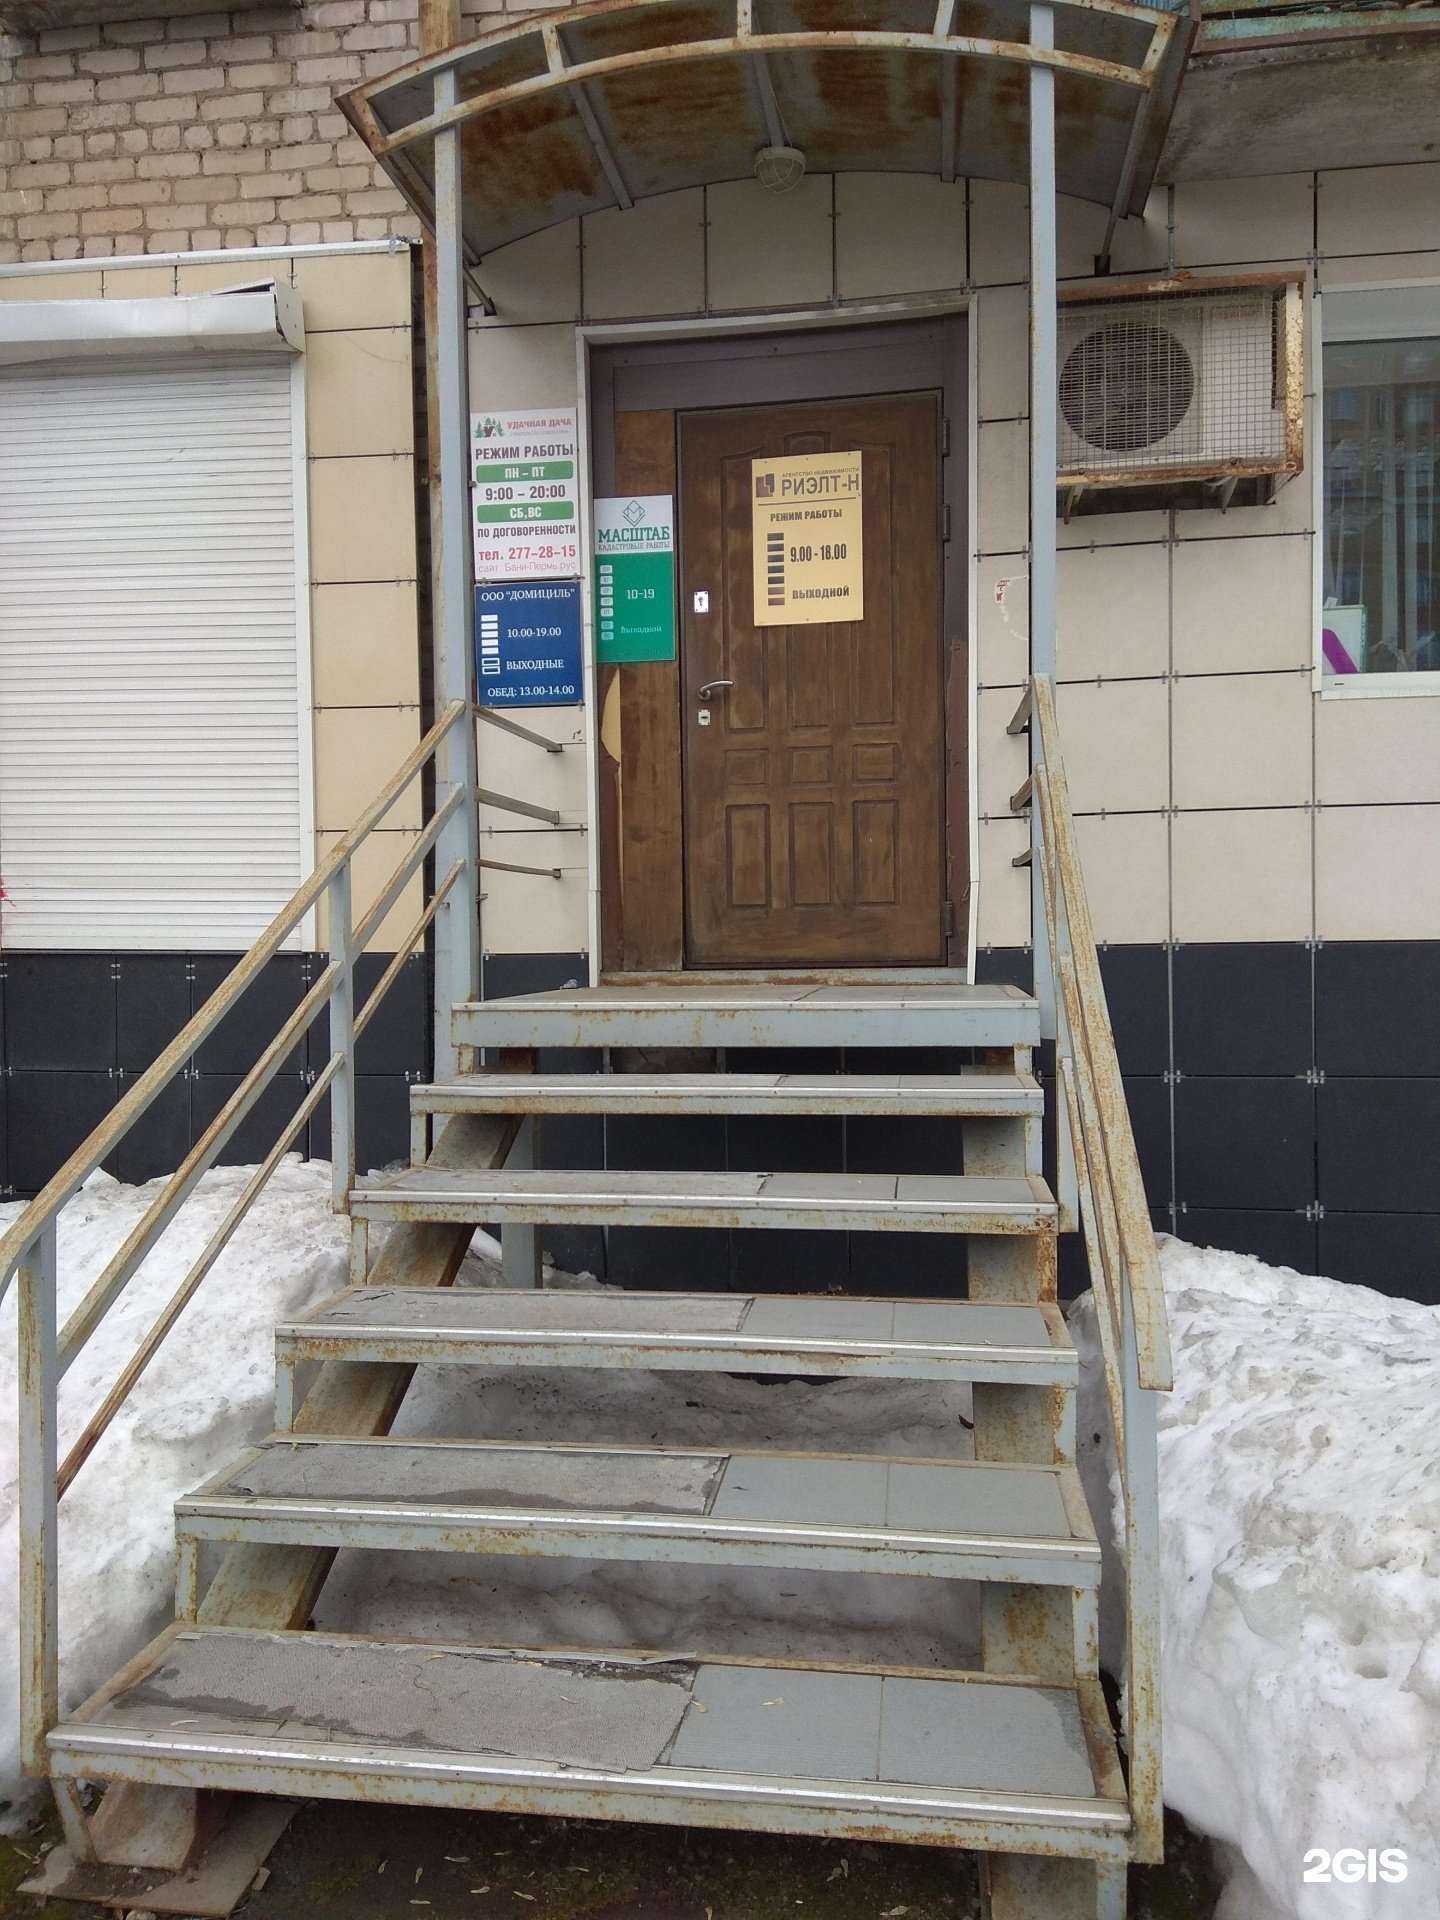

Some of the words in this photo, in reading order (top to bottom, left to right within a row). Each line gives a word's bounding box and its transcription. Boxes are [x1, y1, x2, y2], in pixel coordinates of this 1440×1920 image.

[507, 418, 547, 430] УДАЧНАЯ
[549, 417, 572, 428] ДАЧА
[475, 446, 520, 460] РЕЖИМ
[524, 444, 574, 458] РАБОТЫ
[505, 467, 520, 478] ПН
[532, 466, 545, 477] ПТ
[781, 473, 859, 496] РИЭЛТ-Н
[485, 488, 514, 501] 9:00
[529, 485, 566, 499] 20:00
[770, 511, 802, 522] РЕЖИМ
[805, 508, 842, 520] РАБОТЫ
[477, 528, 491, 539] ПО
[493, 525, 576, 539] ДОГОВОРЕННОСТИ
[598, 526, 670, 543] МАСШТАБ
[479, 550, 504, 561] тел.
[508, 544, 576, 560] 277-28-15
[790, 545, 812, 562] 9.00
[820, 543, 847, 561] 18.00
[481, 591, 505, 601] ООО
[626, 588, 655, 600] 10-19
[792, 585, 850, 601] ВЫХОДНОЙ
[507, 627, 562, 638] 10.00-19.00
[506, 659, 565, 671] ВЫХОДНЫЕ
[488, 687, 518, 698] ОБЕД:
[520, 685, 575, 697] 13.00-14.00
